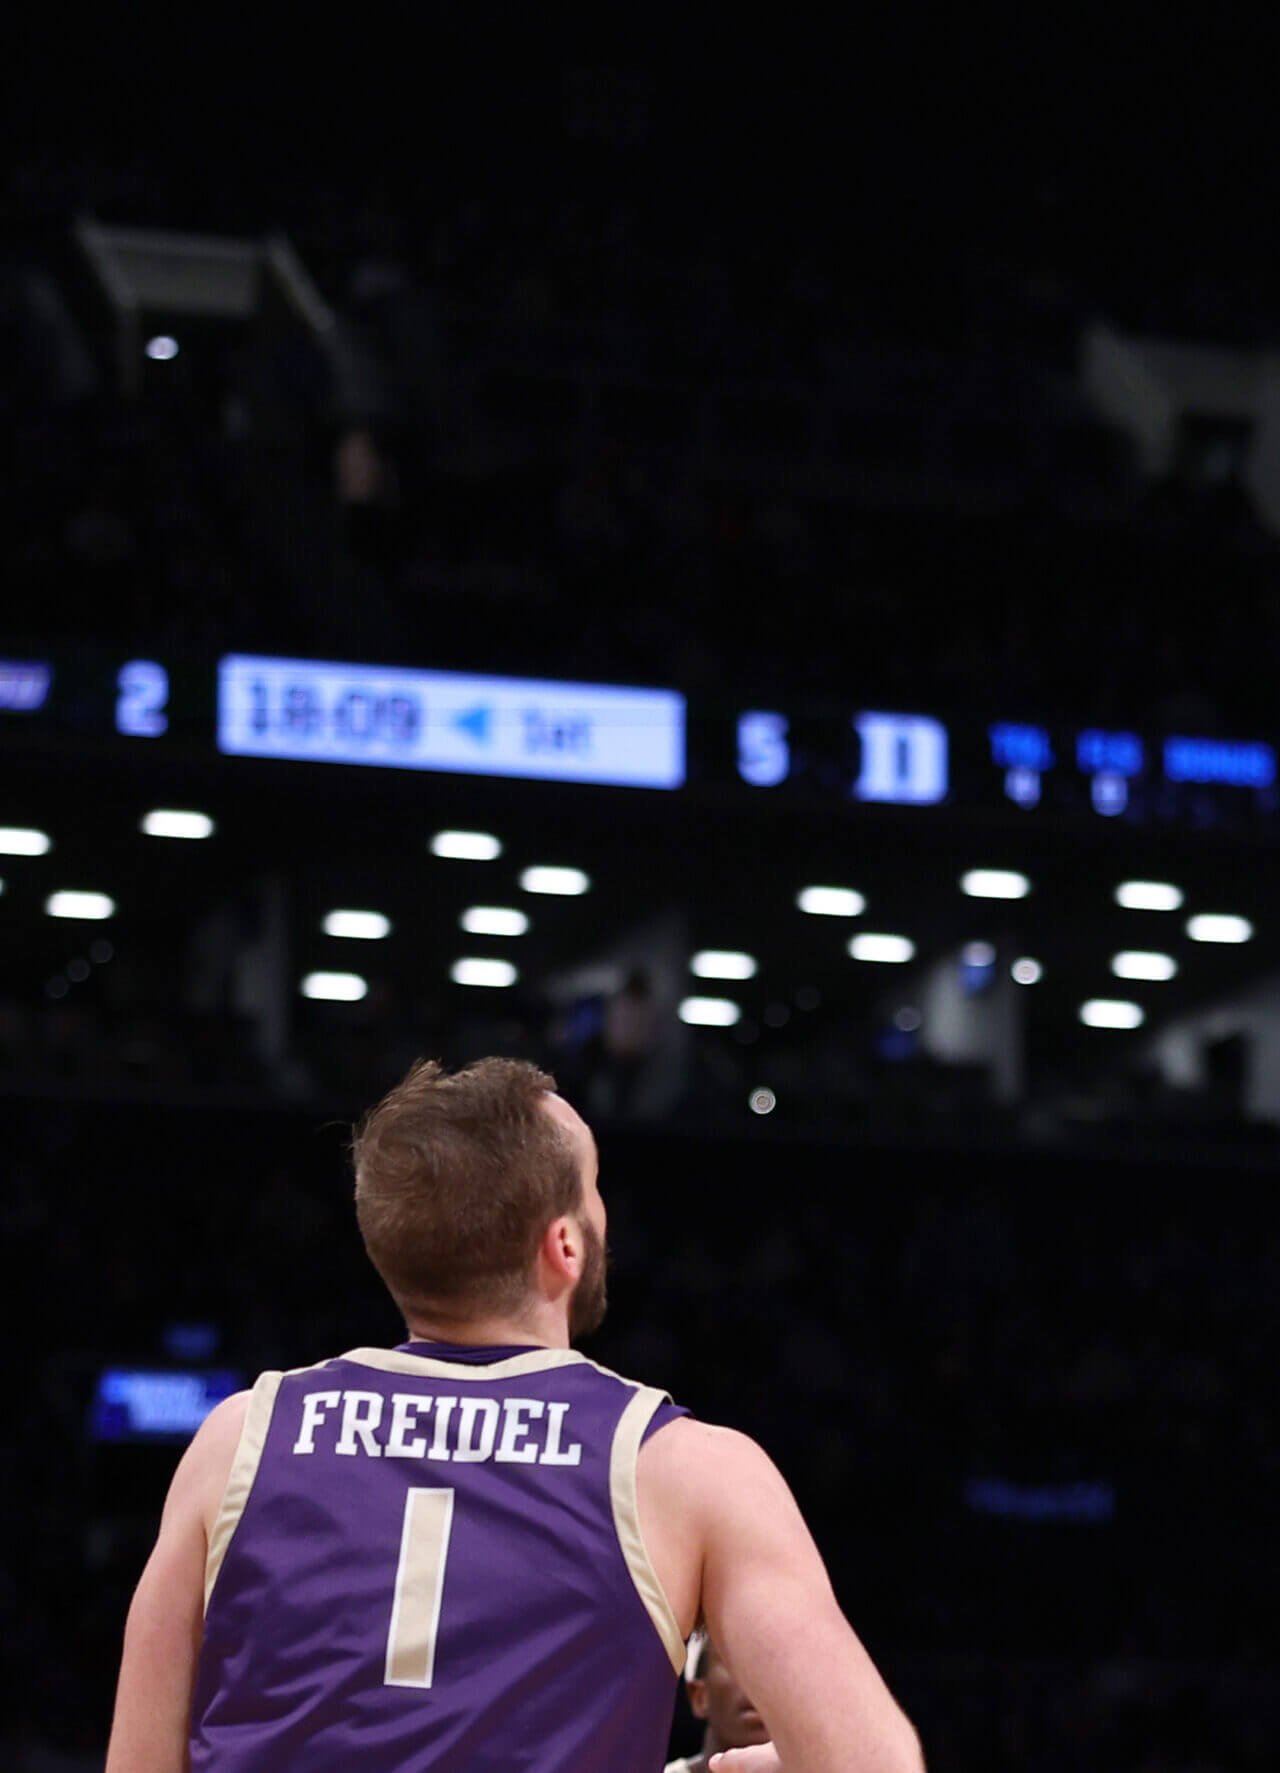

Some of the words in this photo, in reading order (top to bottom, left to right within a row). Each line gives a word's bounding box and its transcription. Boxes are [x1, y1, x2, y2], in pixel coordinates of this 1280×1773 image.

[115, 660, 168, 737] 2
[737, 709, 790, 787] 5
[853, 709, 949, 806] D
[293, 1390, 582, 1466] FREIDEL
[383, 1487, 455, 1688] 1
